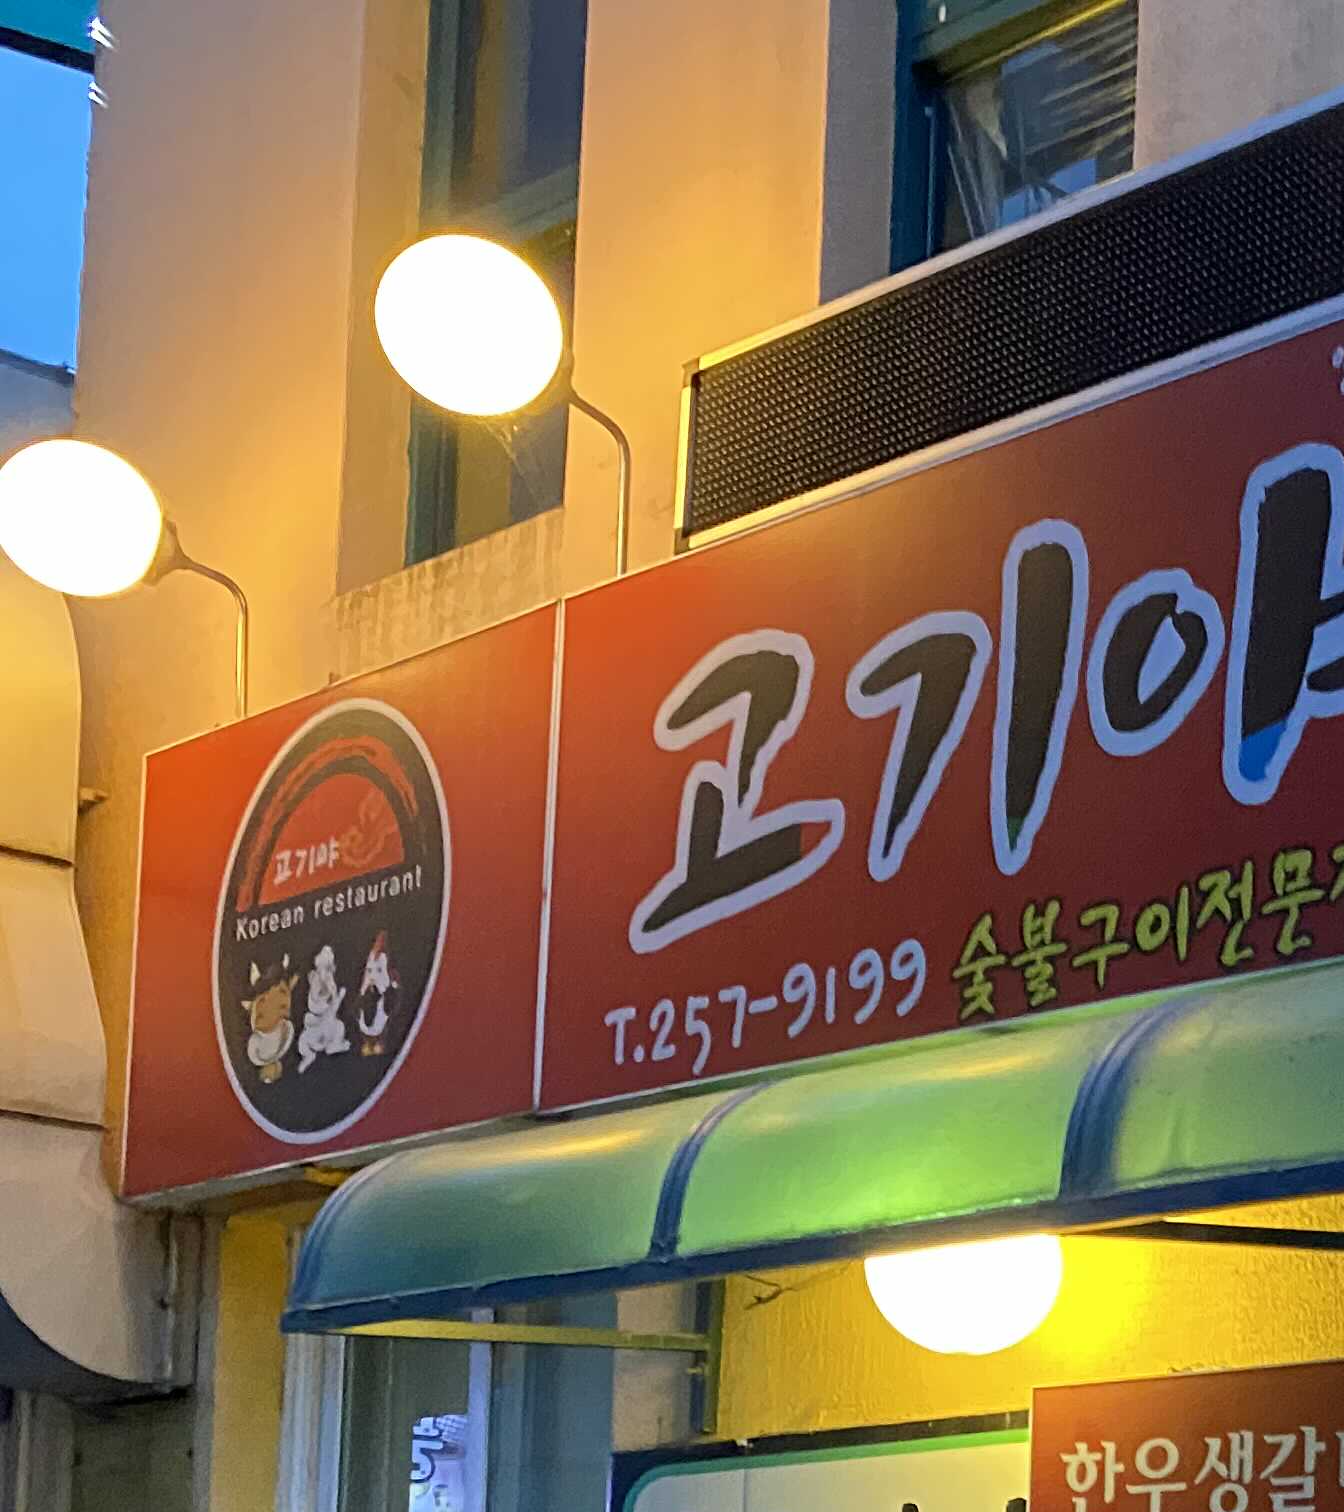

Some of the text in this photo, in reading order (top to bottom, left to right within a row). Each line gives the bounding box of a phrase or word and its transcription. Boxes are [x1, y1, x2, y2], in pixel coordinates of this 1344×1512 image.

[235, 863, 424, 943] Korean restaurant
[604, 937, 928, 1076] T.257-9199
